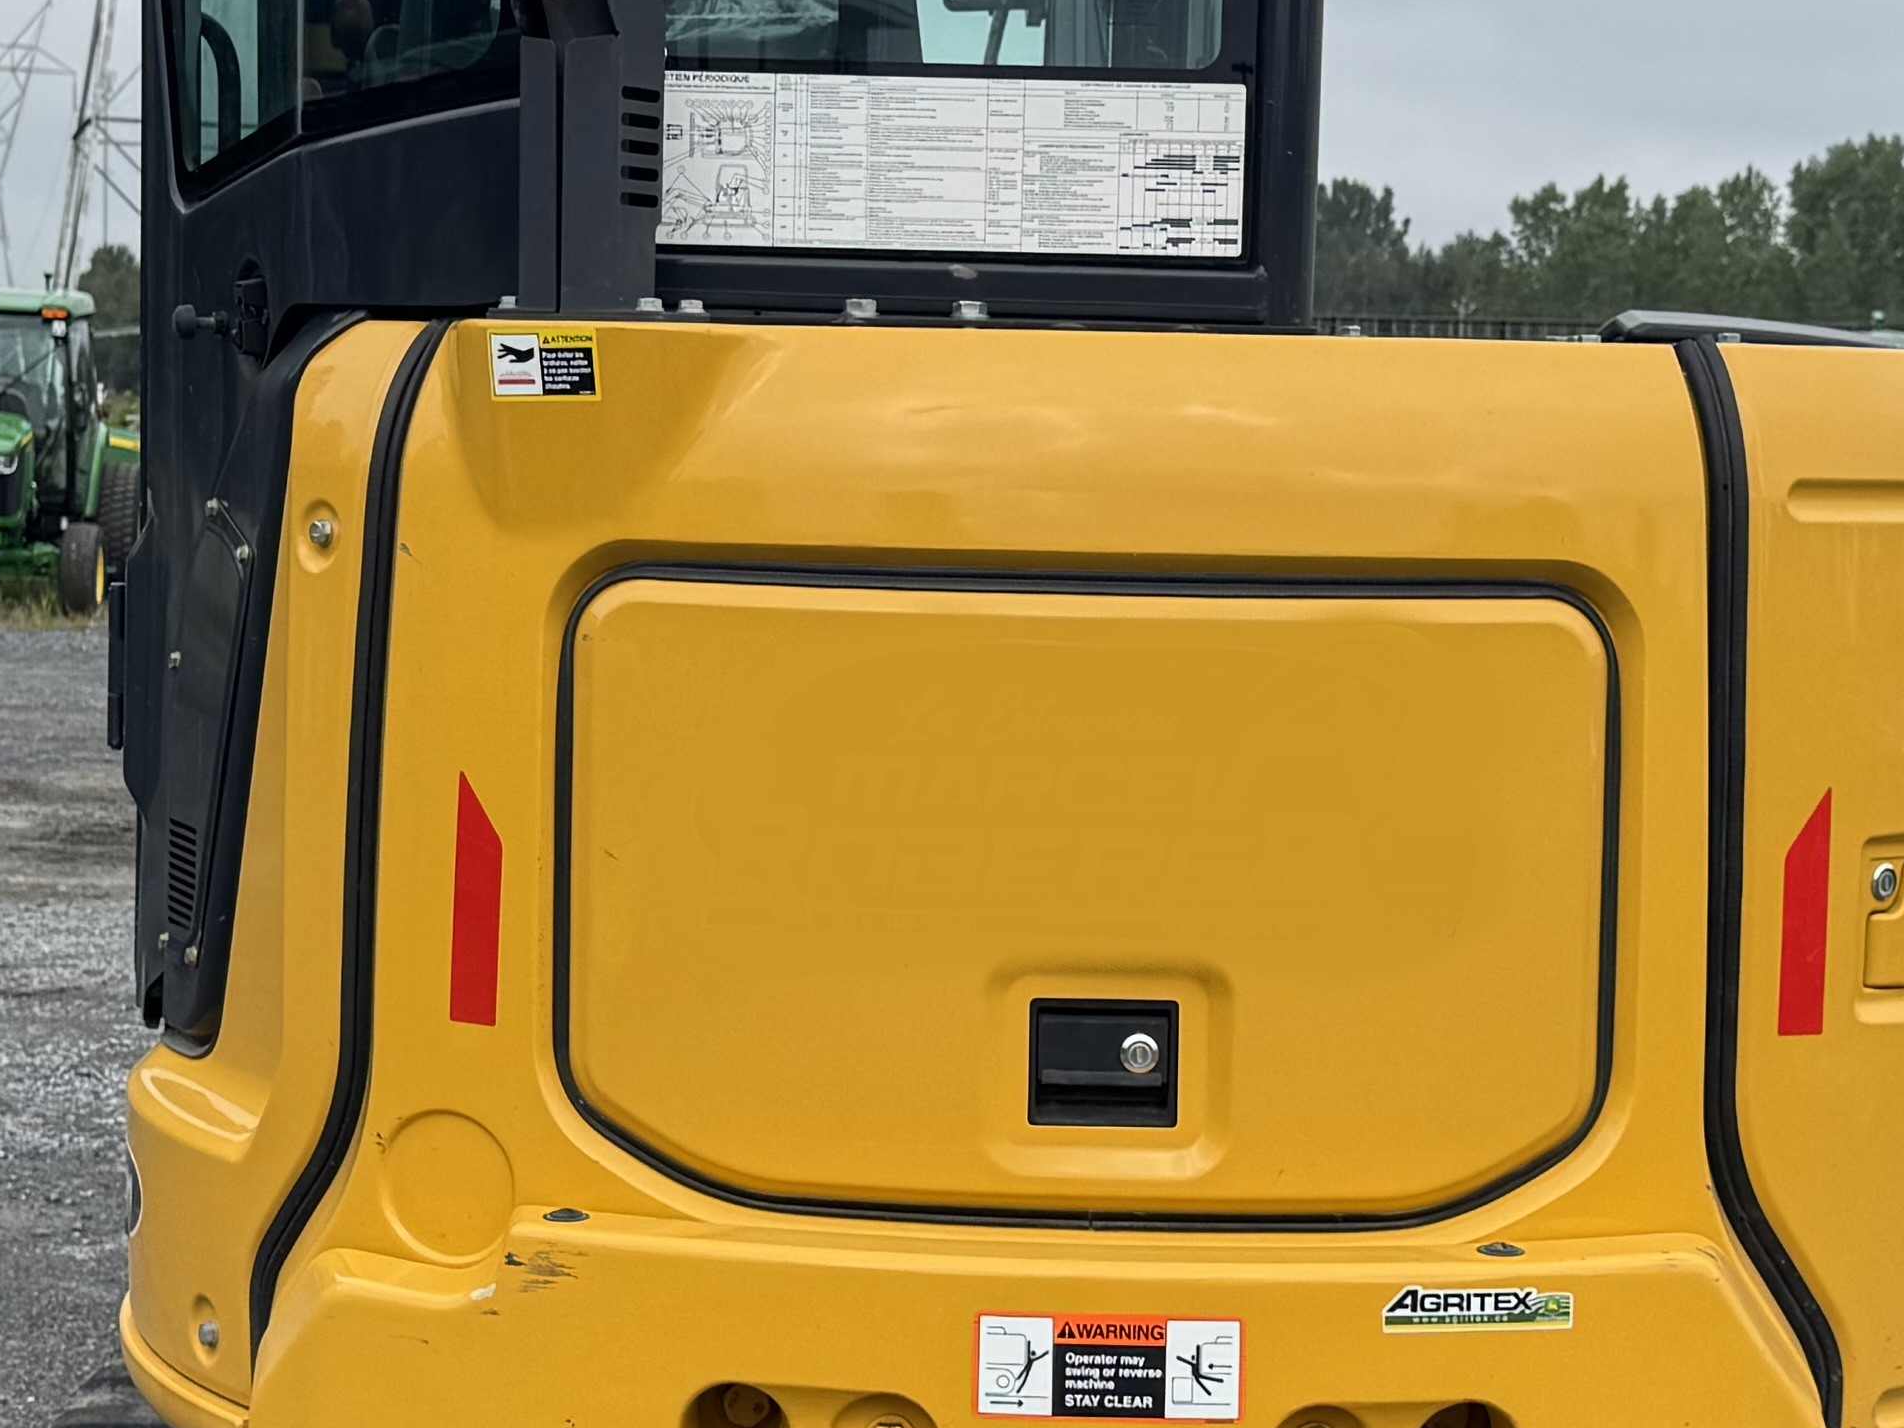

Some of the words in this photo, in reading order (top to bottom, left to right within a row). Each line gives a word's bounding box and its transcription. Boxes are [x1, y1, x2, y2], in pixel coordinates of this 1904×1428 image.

[551, 335, 593, 343] ATTENTION
[1386, 1289, 1534, 1313] AGRITEX
[1075, 1323, 1165, 1341] WARNING
[1065, 1352, 1117, 1366] Operator
[1120, 1356, 1145, 1367] may
[1065, 1366, 1100, 1379] swing
[1102, 1368, 1115, 1377] or
[1119, 1368, 1163, 1378] reverse
[1065, 1378, 1115, 1390] machine
[1065, 1394, 1100, 1407] STAY
[1104, 1395, 1153, 1408] CLEAR
